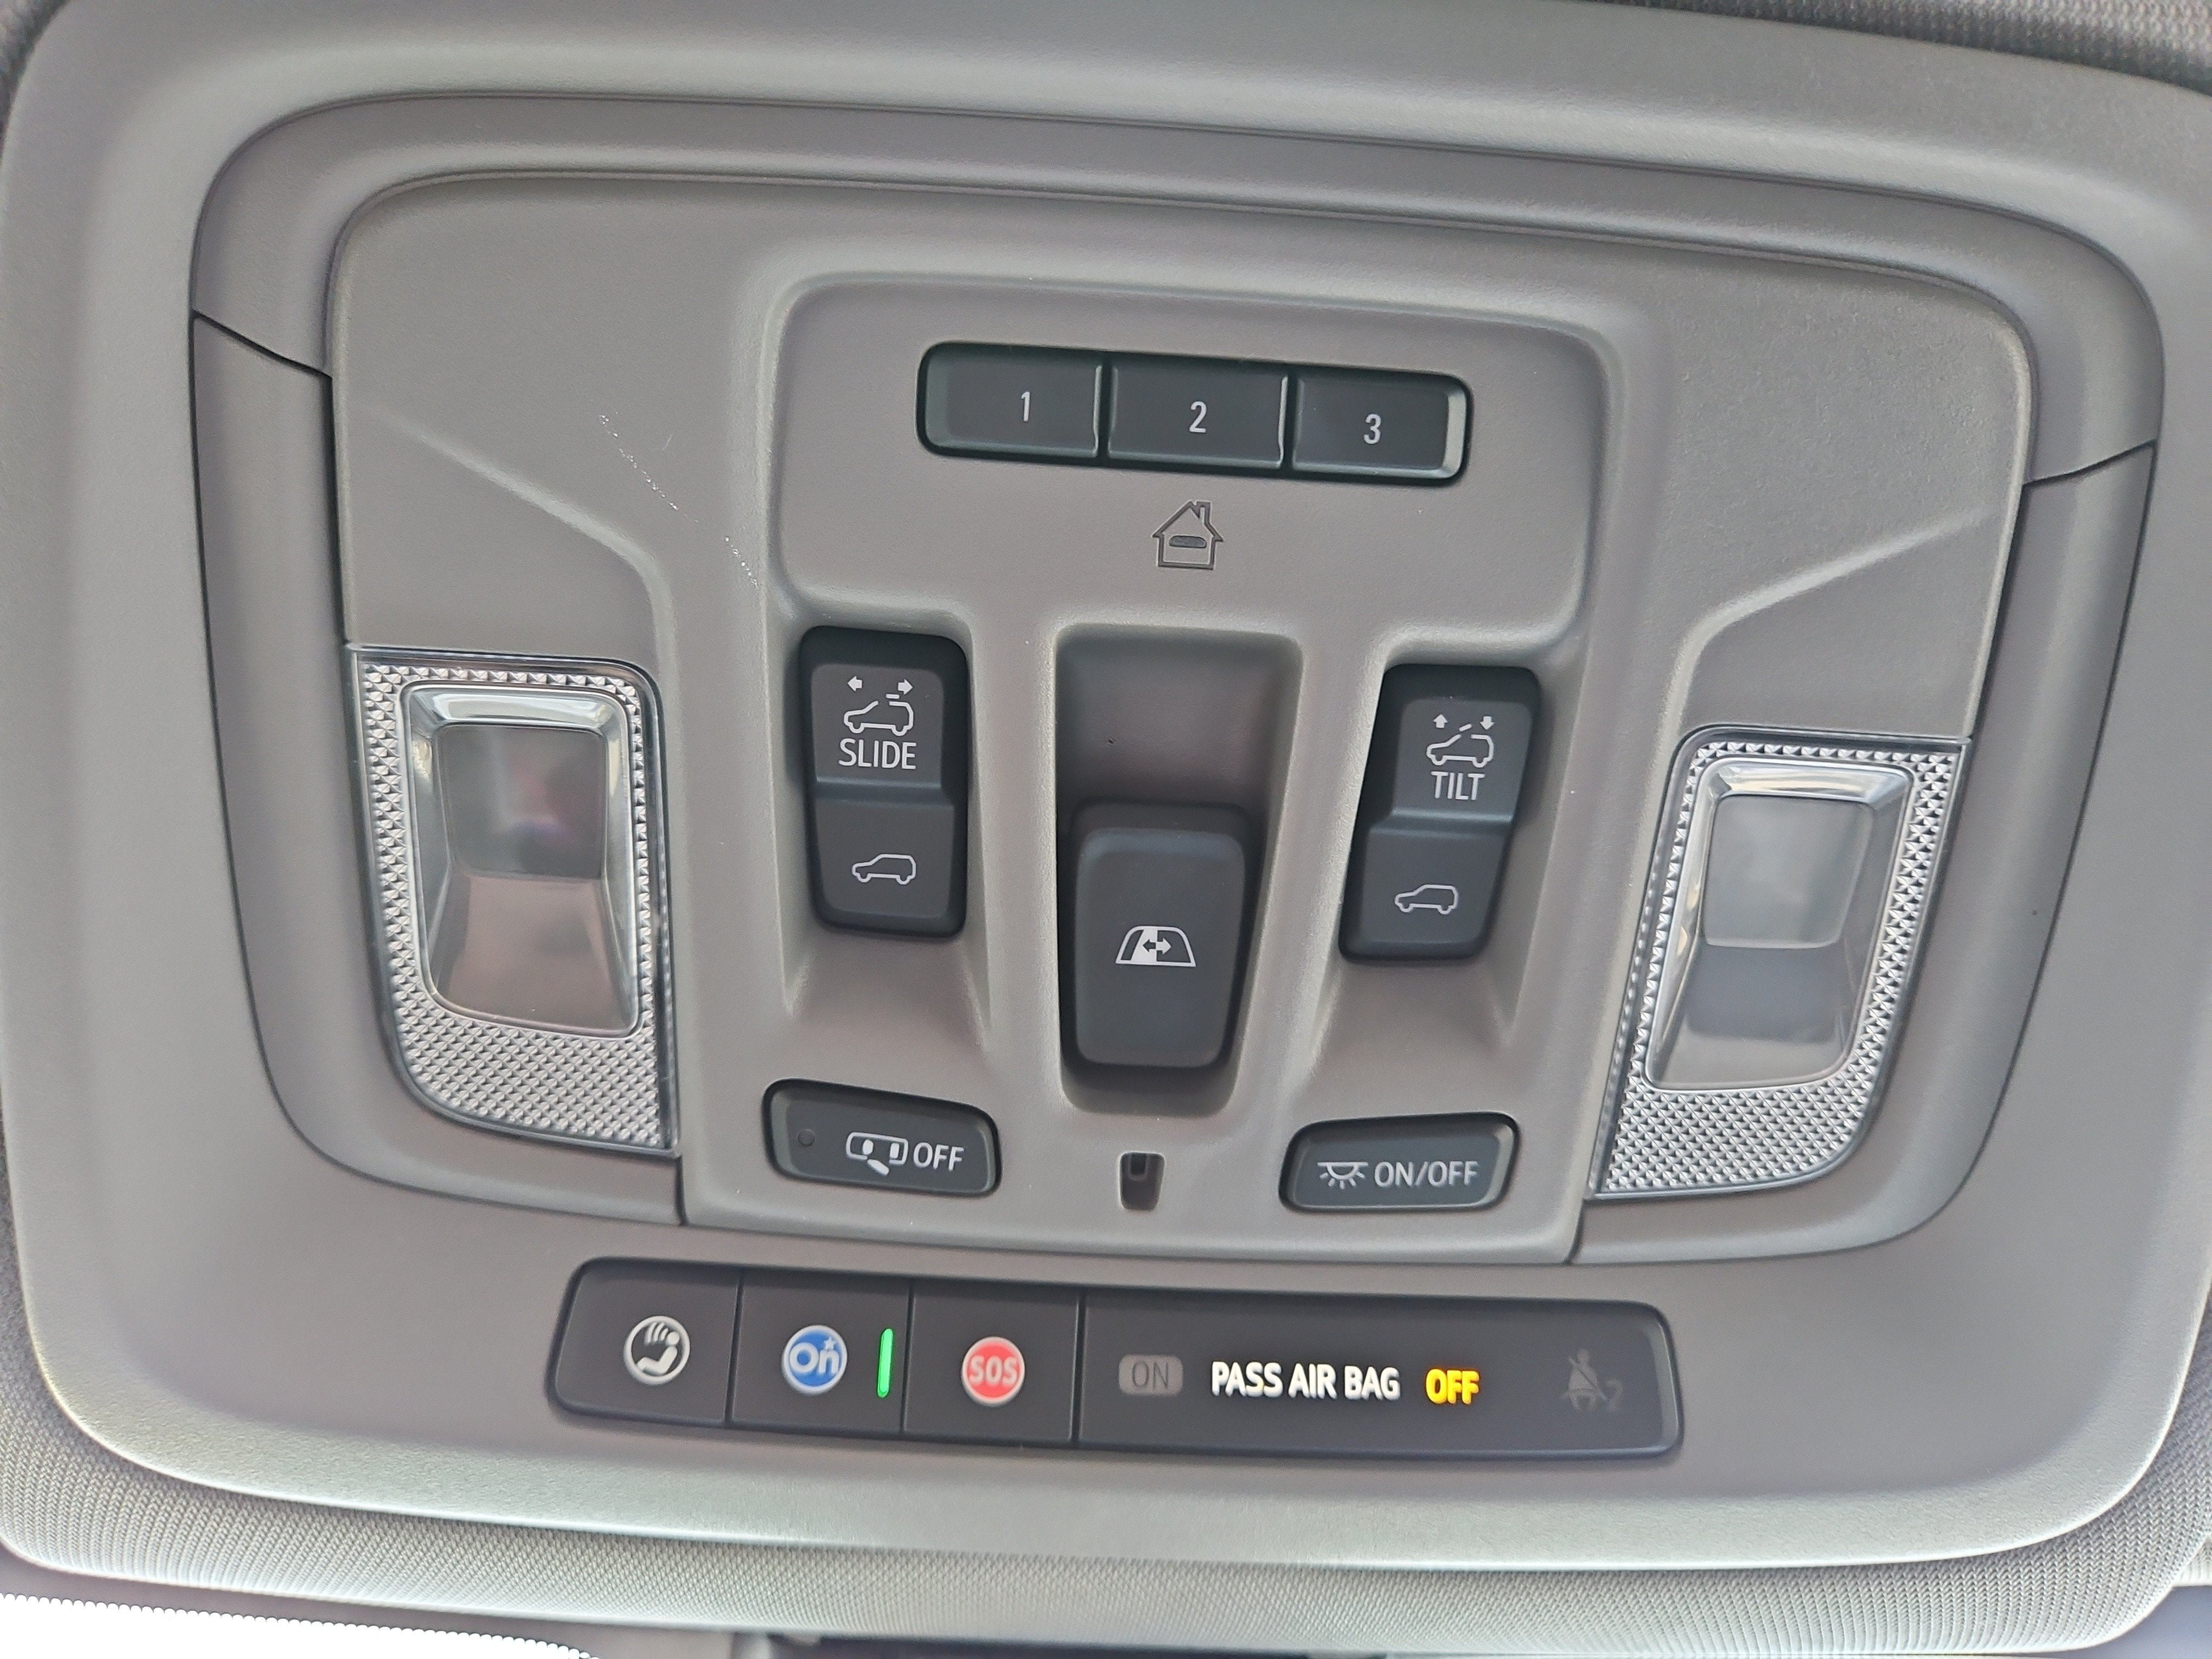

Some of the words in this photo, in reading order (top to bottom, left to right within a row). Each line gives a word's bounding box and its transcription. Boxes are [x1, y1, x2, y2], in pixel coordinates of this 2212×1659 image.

[1020, 391, 1031, 422] 1
[1189, 401, 1207, 433] 2
[1362, 414, 1382, 445] 3
[838, 738, 917, 770] SLIDE
[1430, 770, 1486, 801] TILT
[913, 1142, 965, 1172] OFF
[1374, 1161, 1479, 1187] ON/OFF
[969, 1355, 1018, 1385] SOS
[1131, 1362, 1169, 1390] ON
[1211, 1361, 1283, 1398] PASS
[1289, 1363, 1338, 1399] AIR
[1343, 1366, 1401, 1401] BAG
[1425, 1369, 1481, 1405] OFF
